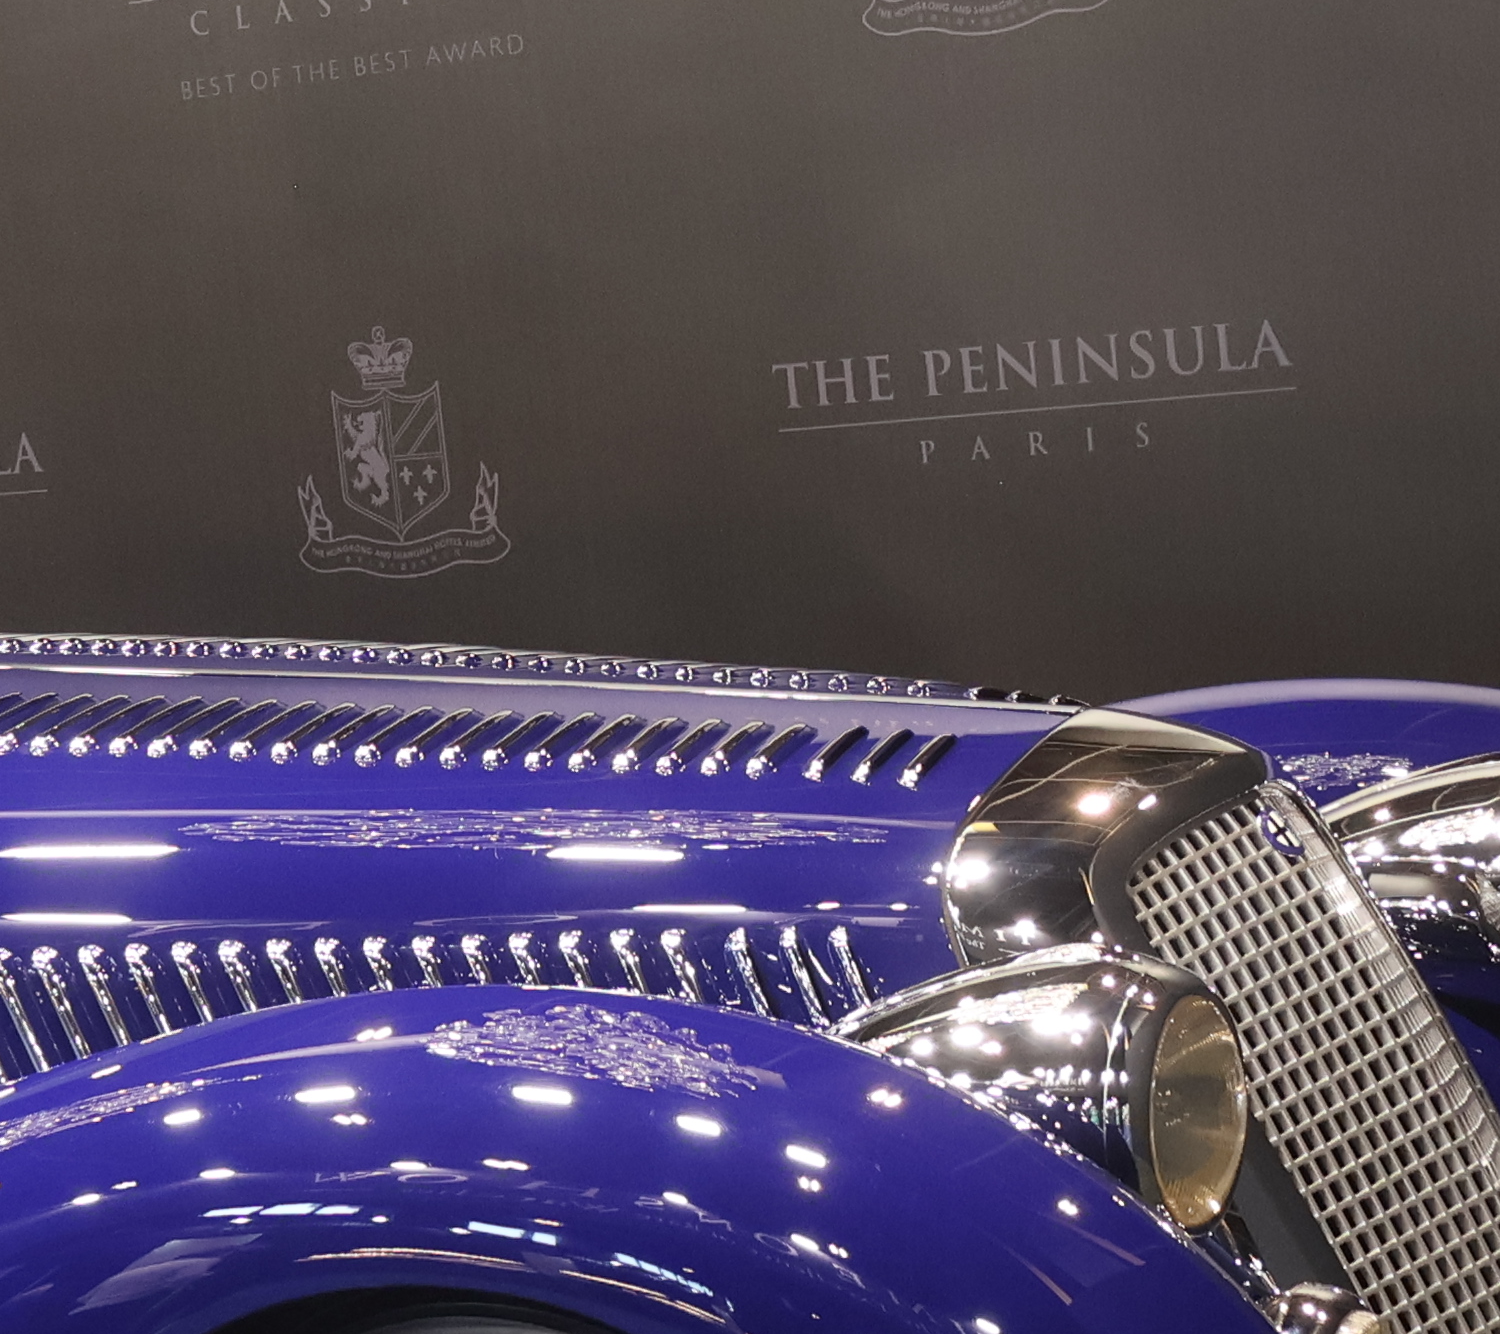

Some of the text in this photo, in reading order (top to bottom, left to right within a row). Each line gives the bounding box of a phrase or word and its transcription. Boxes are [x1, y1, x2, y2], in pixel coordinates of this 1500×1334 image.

[180, 33, 525, 101] BEST OF THE BEST AWARD
[771, 318, 1294, 410] THE PENINSULA
[918, 421, 1151, 465] PARIS
